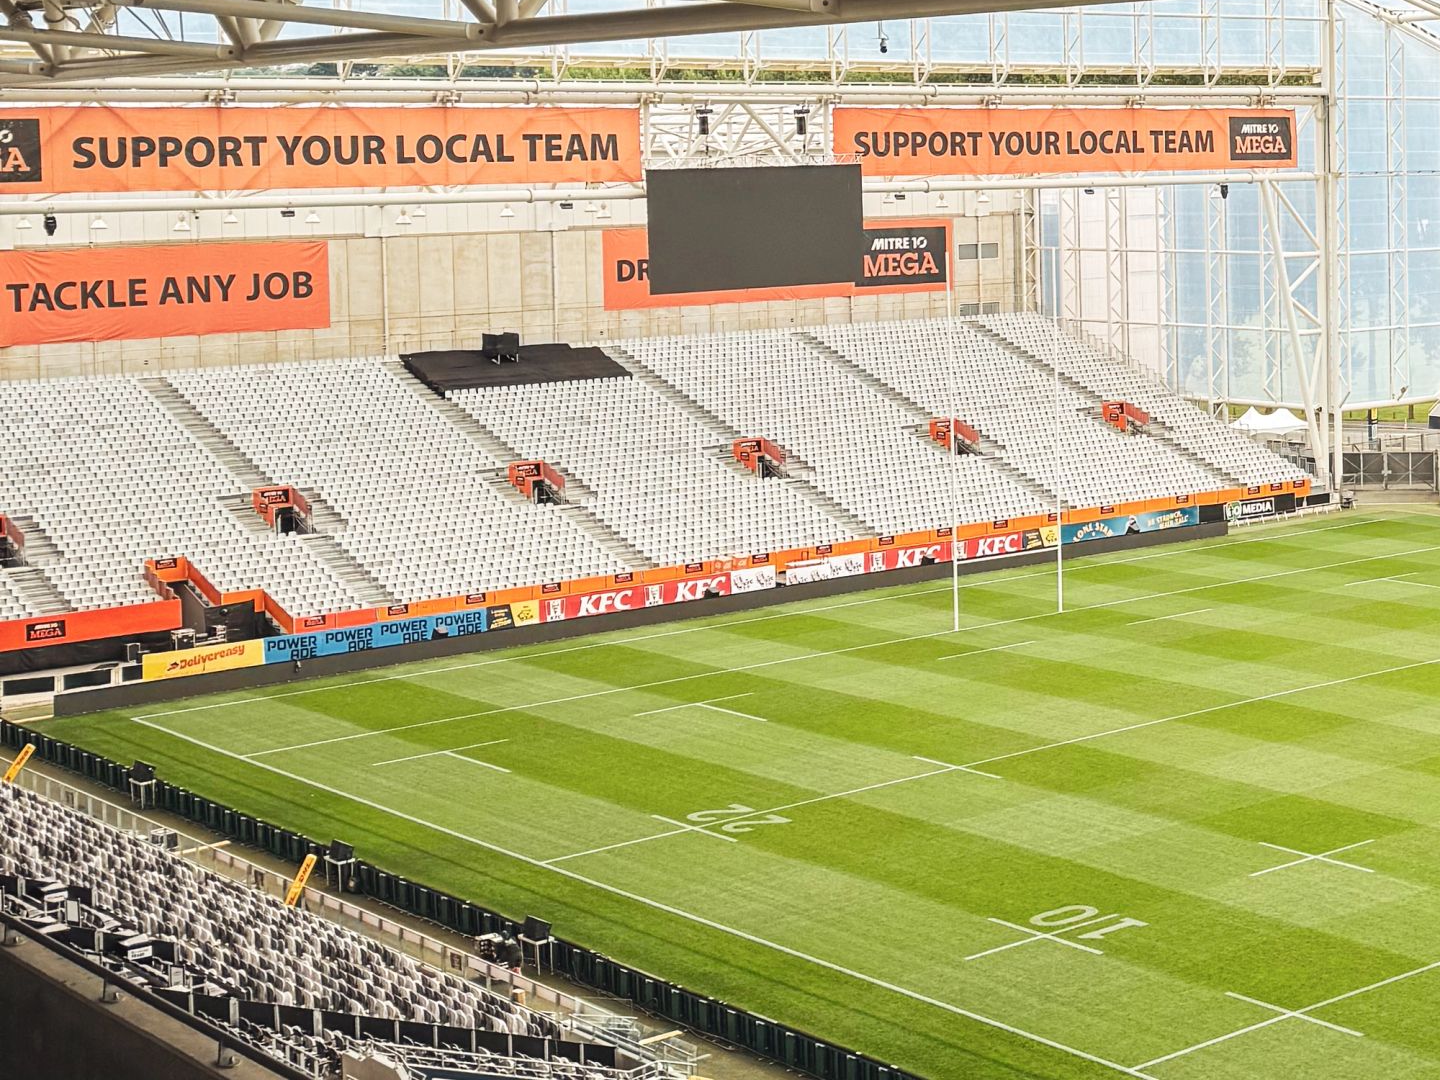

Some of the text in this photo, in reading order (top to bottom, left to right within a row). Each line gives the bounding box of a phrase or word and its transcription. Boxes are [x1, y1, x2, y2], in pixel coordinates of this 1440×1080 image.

[1241, 123, 1267, 134] MITRE
[73, 133, 619, 170] SUPPORT YOUR LOCAL TEAM
[854, 129, 1214, 157] SUPPORT YOUR LOCAL TEAM
[1234, 136, 1287, 154] MEGA
[871, 236, 928, 251] MITRE 10
[863, 251, 939, 278] MEGA
[6, 271, 314, 313] TACKLE ANY JOB
[1242, 501, 1272, 515] MEDIA
[976, 534, 1019, 557] KFC
[896, 546, 942, 569] KFC
[675, 575, 726, 603] KFC
[577, 590, 632, 617] KFC
[381, 619, 427, 636] POWER
[435, 611, 481, 627] POWER
[30, 628, 62, 639] MEGA
[325, 626, 373, 644] POWER
[403, 629, 428, 644] ADE
[457, 622, 481, 636] ADE
[267, 635, 317, 652] POWER
[348, 639, 373, 652] ADE
[180, 644, 245, 670] Delivereasy
[290, 645, 317, 660] ADE
